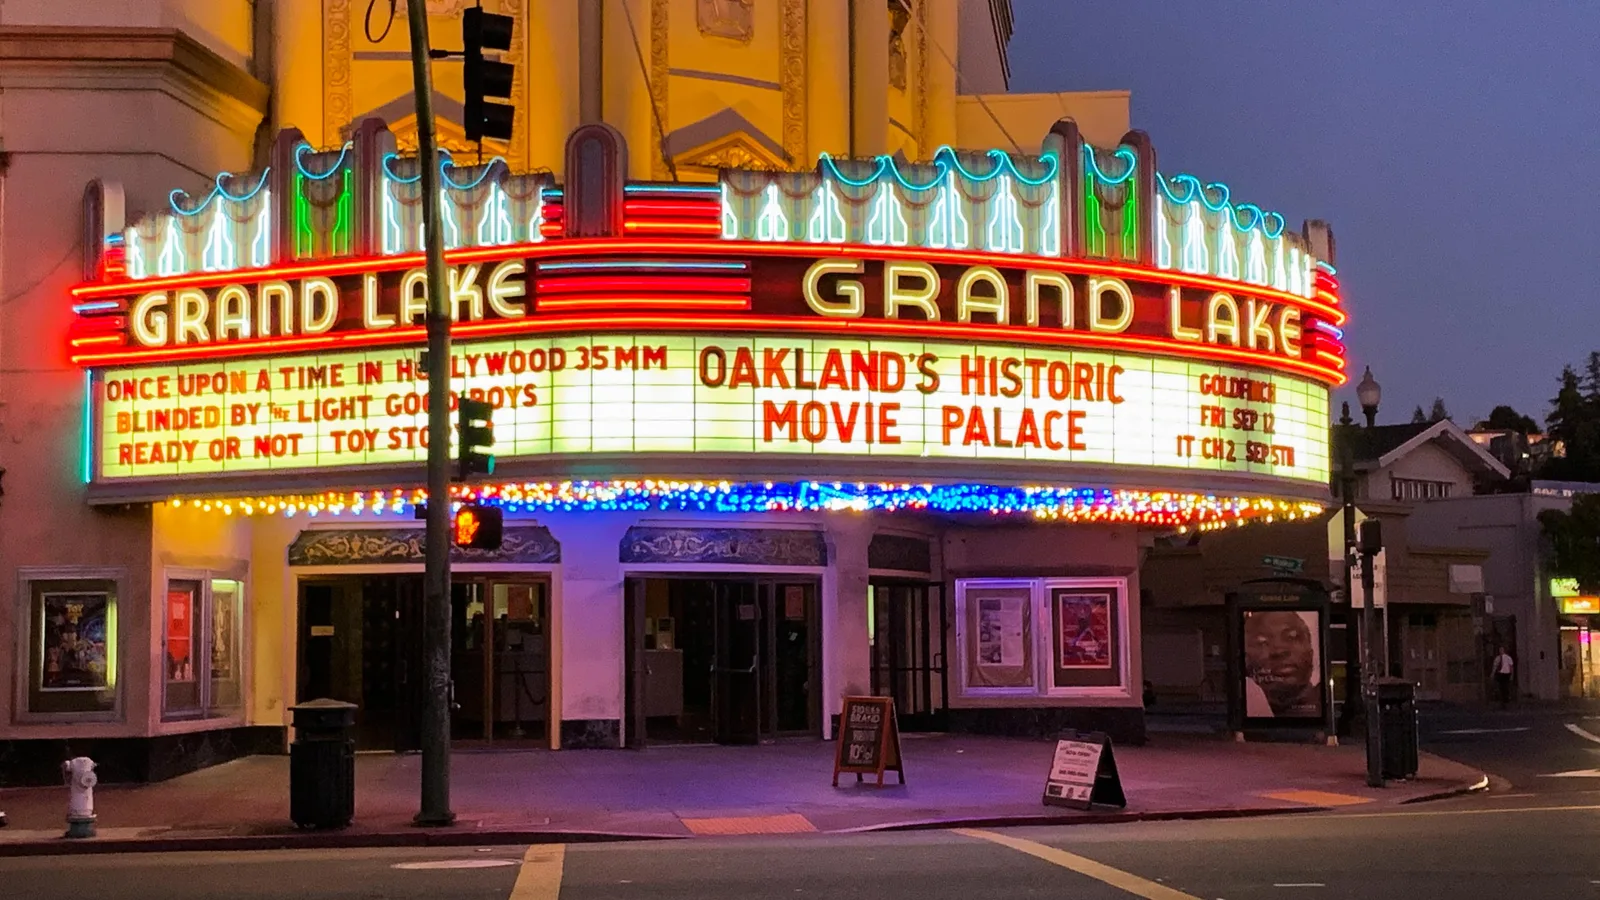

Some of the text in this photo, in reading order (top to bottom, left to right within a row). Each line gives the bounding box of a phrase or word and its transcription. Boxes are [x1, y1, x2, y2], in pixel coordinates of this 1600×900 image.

[132, 259, 528, 347] GRAND LAKE
[802, 259, 1302, 358] GRAND LAKE
[106, 345, 668, 402] ONCE UPON A TIME IN HLYWOOD 35MM
[699, 346, 1126, 404] OAKLAND'S HISTORIC
[116, 405, 221, 434] BLINDED
[231, 402, 261, 427] BY
[268, 402, 290, 422] THE
[298, 394, 374, 423] LIGHT
[763, 401, 1087, 451] MOVIE PALACE
[1200, 404, 1226, 429] FRI
[1232, 407, 1259, 431] SEP
[119, 439, 199, 466] READY
[209, 436, 242, 462] OR
[254, 433, 304, 458] NOT
[330, 428, 380, 455] TOY
[387, 423, 461, 451] STO
[1176, 435, 1195, 458] IT
[1201, 437, 1225, 460] CH
